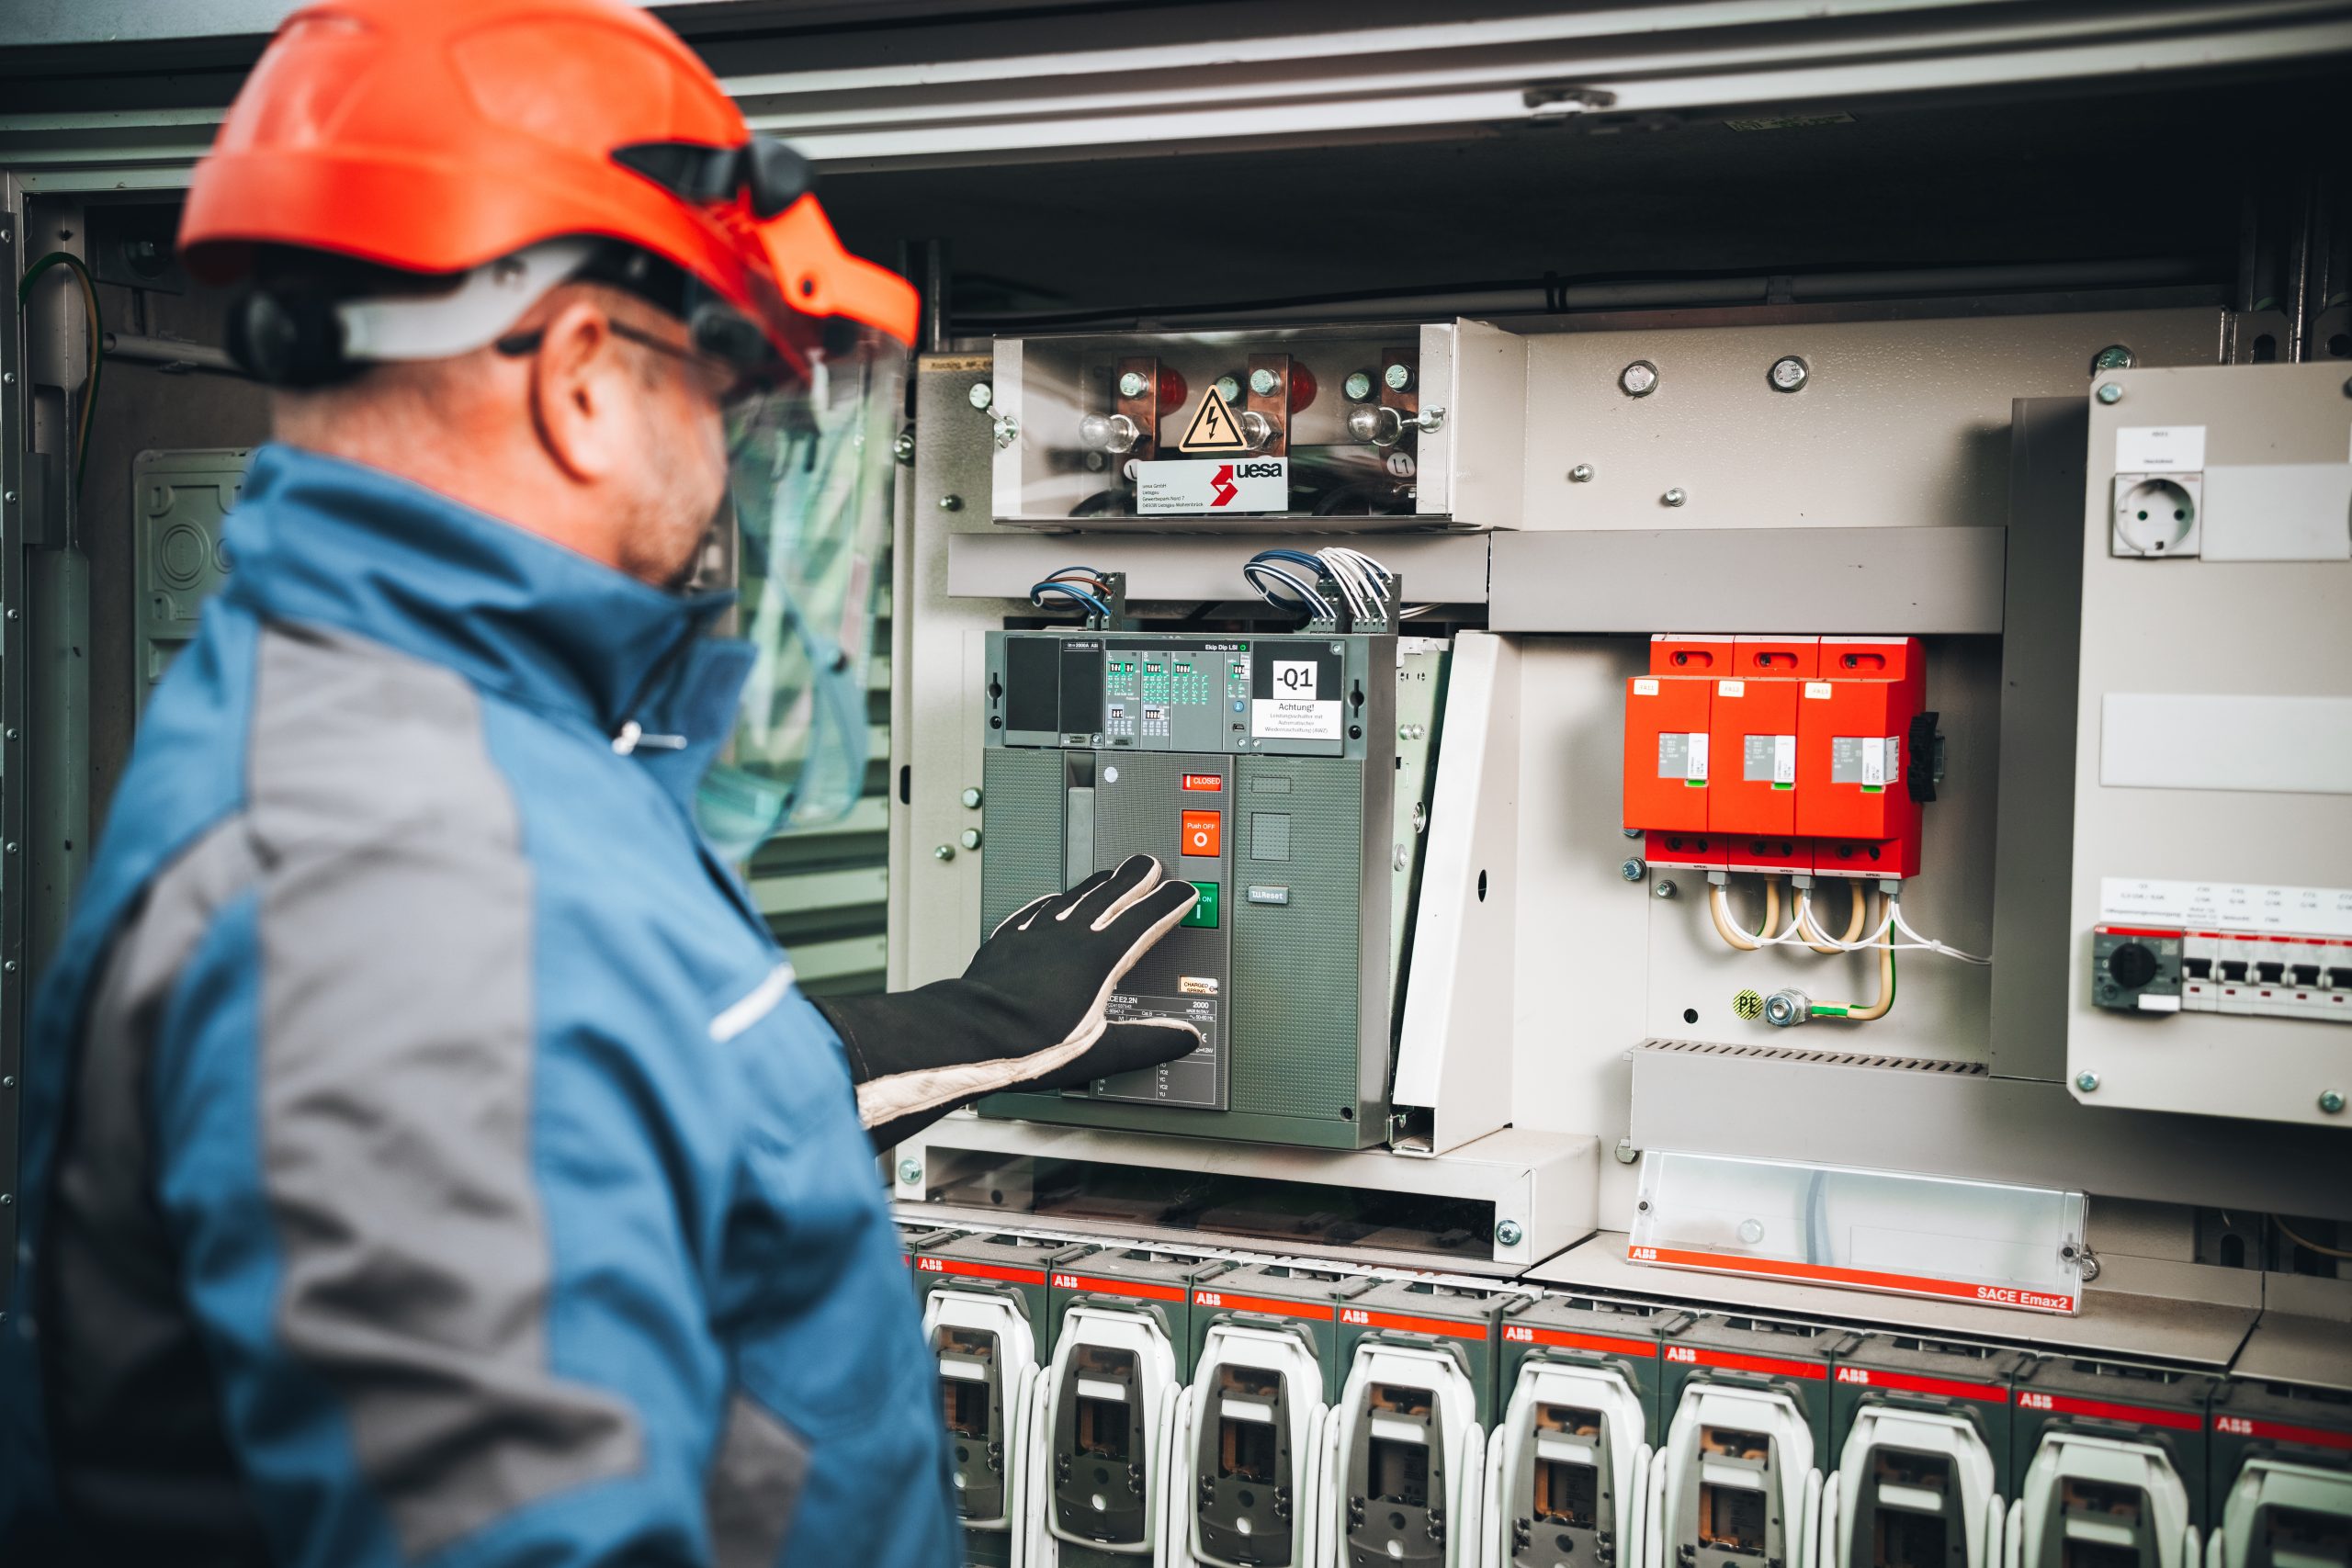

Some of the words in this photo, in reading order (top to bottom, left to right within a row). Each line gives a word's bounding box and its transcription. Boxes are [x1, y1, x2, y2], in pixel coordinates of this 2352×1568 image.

[1236, 463, 1283, 479] uesa
[1393, 458, 1409, 474] L1
[1276, 668, 1314, 691] -Q1
[1278, 703, 1315, 713] Achtung!
[1193, 1001, 1209, 1010] 2000
[1739, 996, 1758, 1015] PE
[1632, 1247, 1657, 1260] ABB
[921, 1258, 944, 1271] ABB
[1054, 1274, 1079, 1289] ABB
[1196, 1292, 1221, 1306] ABB
[1977, 1287, 2018, 1303] SACE
[2019, 1292, 2068, 1309] Emax2
[1342, 1309, 1369, 1325] ABB
[1506, 1326, 1533, 1342] ABB
[1667, 1347, 1696, 1362] ABB
[1838, 1367, 1869, 1383] ABB
[2019, 1392, 2053, 1409] ABB
[2216, 1416, 2253, 1434] ABB
